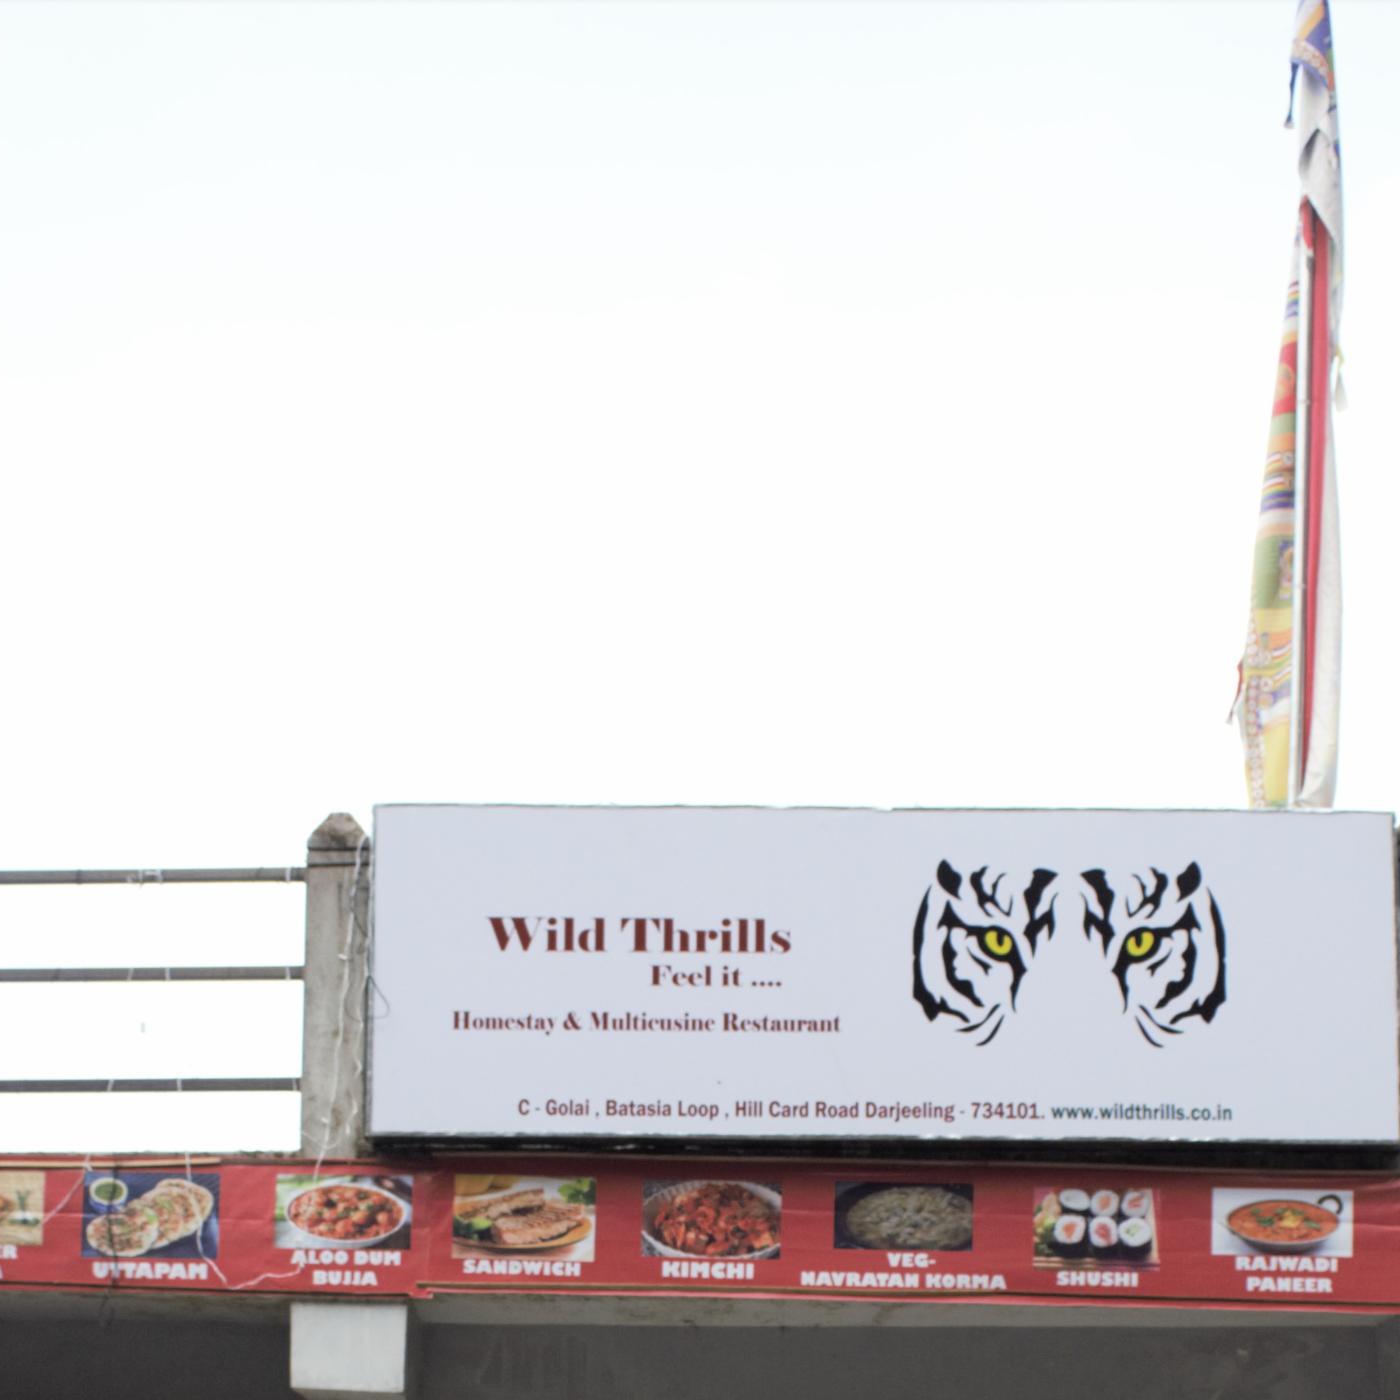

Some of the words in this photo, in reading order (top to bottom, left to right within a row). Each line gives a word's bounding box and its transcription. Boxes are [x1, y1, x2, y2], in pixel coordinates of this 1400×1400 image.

[488, 916, 607, 952] Wild
[621, 918, 792, 953] Thrills
[650, 965, 712, 987] Feel
[722, 965, 741, 987] it
[452, 1011, 556, 1035] Homestay
[563, 1012, 582, 1031] &
[590, 1012, 715, 1033] Multicusine
[722, 1013, 841, 1033] Restaurant
[518, 1100, 530, 1115] C
[546, 1099, 589, 1116] Golai
[606, 1100, 672, 1117] Batasia
[678, 1100, 719, 1120] Loop
[736, 1101, 763, 1118] Hill
[769, 1101, 808, 1118] Card
[815, 1101, 859, 1118] Road
[865, 1101, 955, 1122] Darjeeling
[1051, 1103, 1233, 1121] www.wildthrills.co.in
[291, 1250, 348, 1266] ALOO
[354, 1251, 402, 1266] DUM
[887, 1253, 936, 1268] VEG-
[1235, 1257, 1338, 1273] RAJWADI
[463, 1259, 581, 1277] SANDWICH
[662, 1261, 754, 1280] KIMCHI
[801, 1271, 920, 1288] NAVRATAN
[926, 1273, 1007, 1290] KORMA
[1057, 1271, 1138, 1287] SHUSHI
[1246, 1277, 1333, 1293] PANEER
